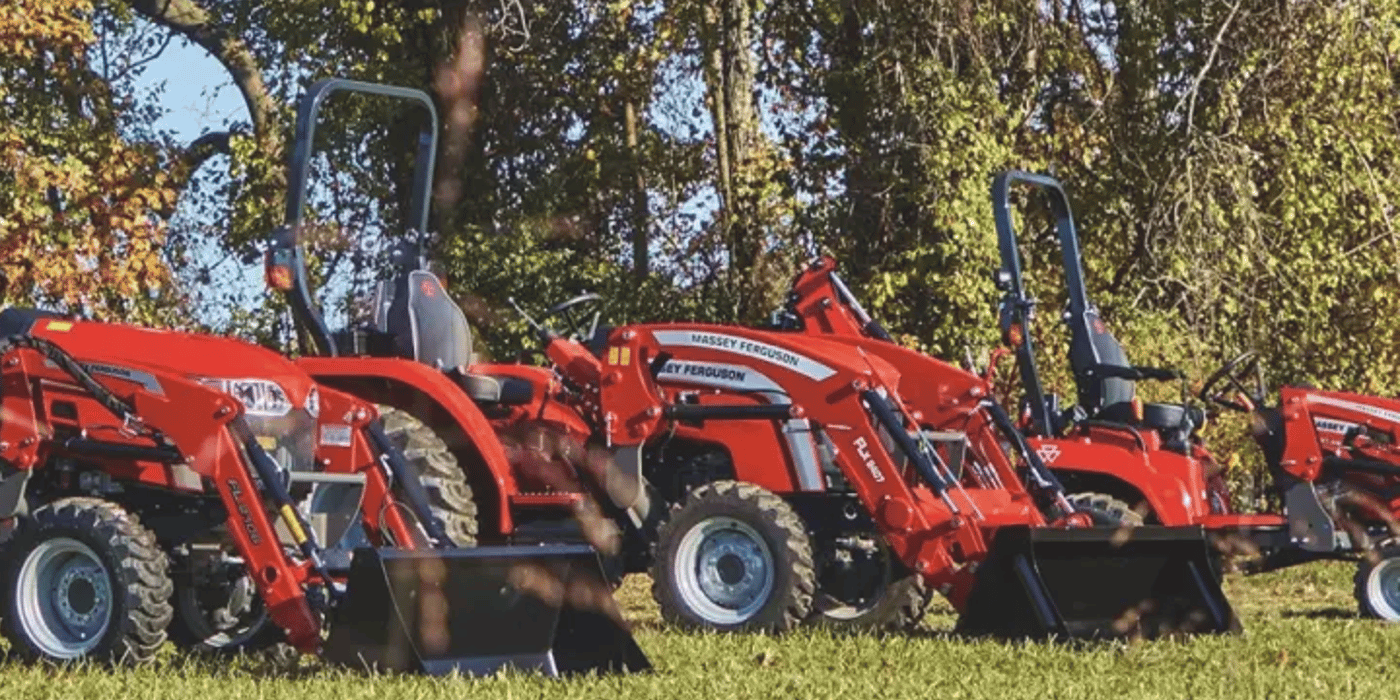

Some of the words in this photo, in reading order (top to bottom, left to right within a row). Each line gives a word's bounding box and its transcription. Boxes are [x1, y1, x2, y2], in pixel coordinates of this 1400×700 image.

[691, 333, 738, 348] MASSEY
[740, 341, 800, 366] FERGUSON
[684, 364, 746, 382] FERGUSON
